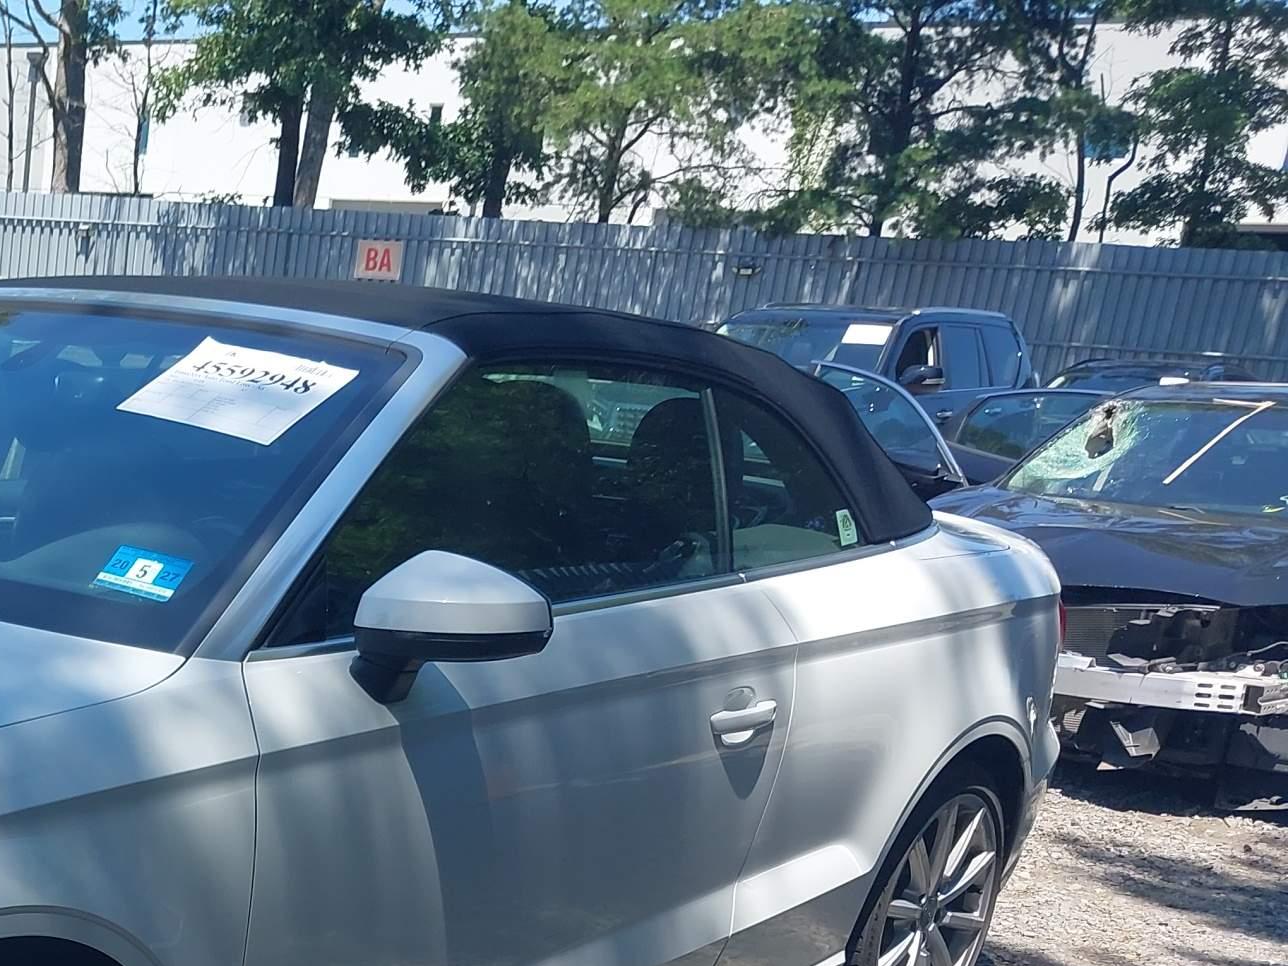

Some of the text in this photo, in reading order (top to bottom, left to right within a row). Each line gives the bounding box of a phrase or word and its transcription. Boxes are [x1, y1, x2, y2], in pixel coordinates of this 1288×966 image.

[364, 247, 392, 272] BA
[193, 360, 317, 395] 45592948
[111, 558, 182, 582] 20 5 27
